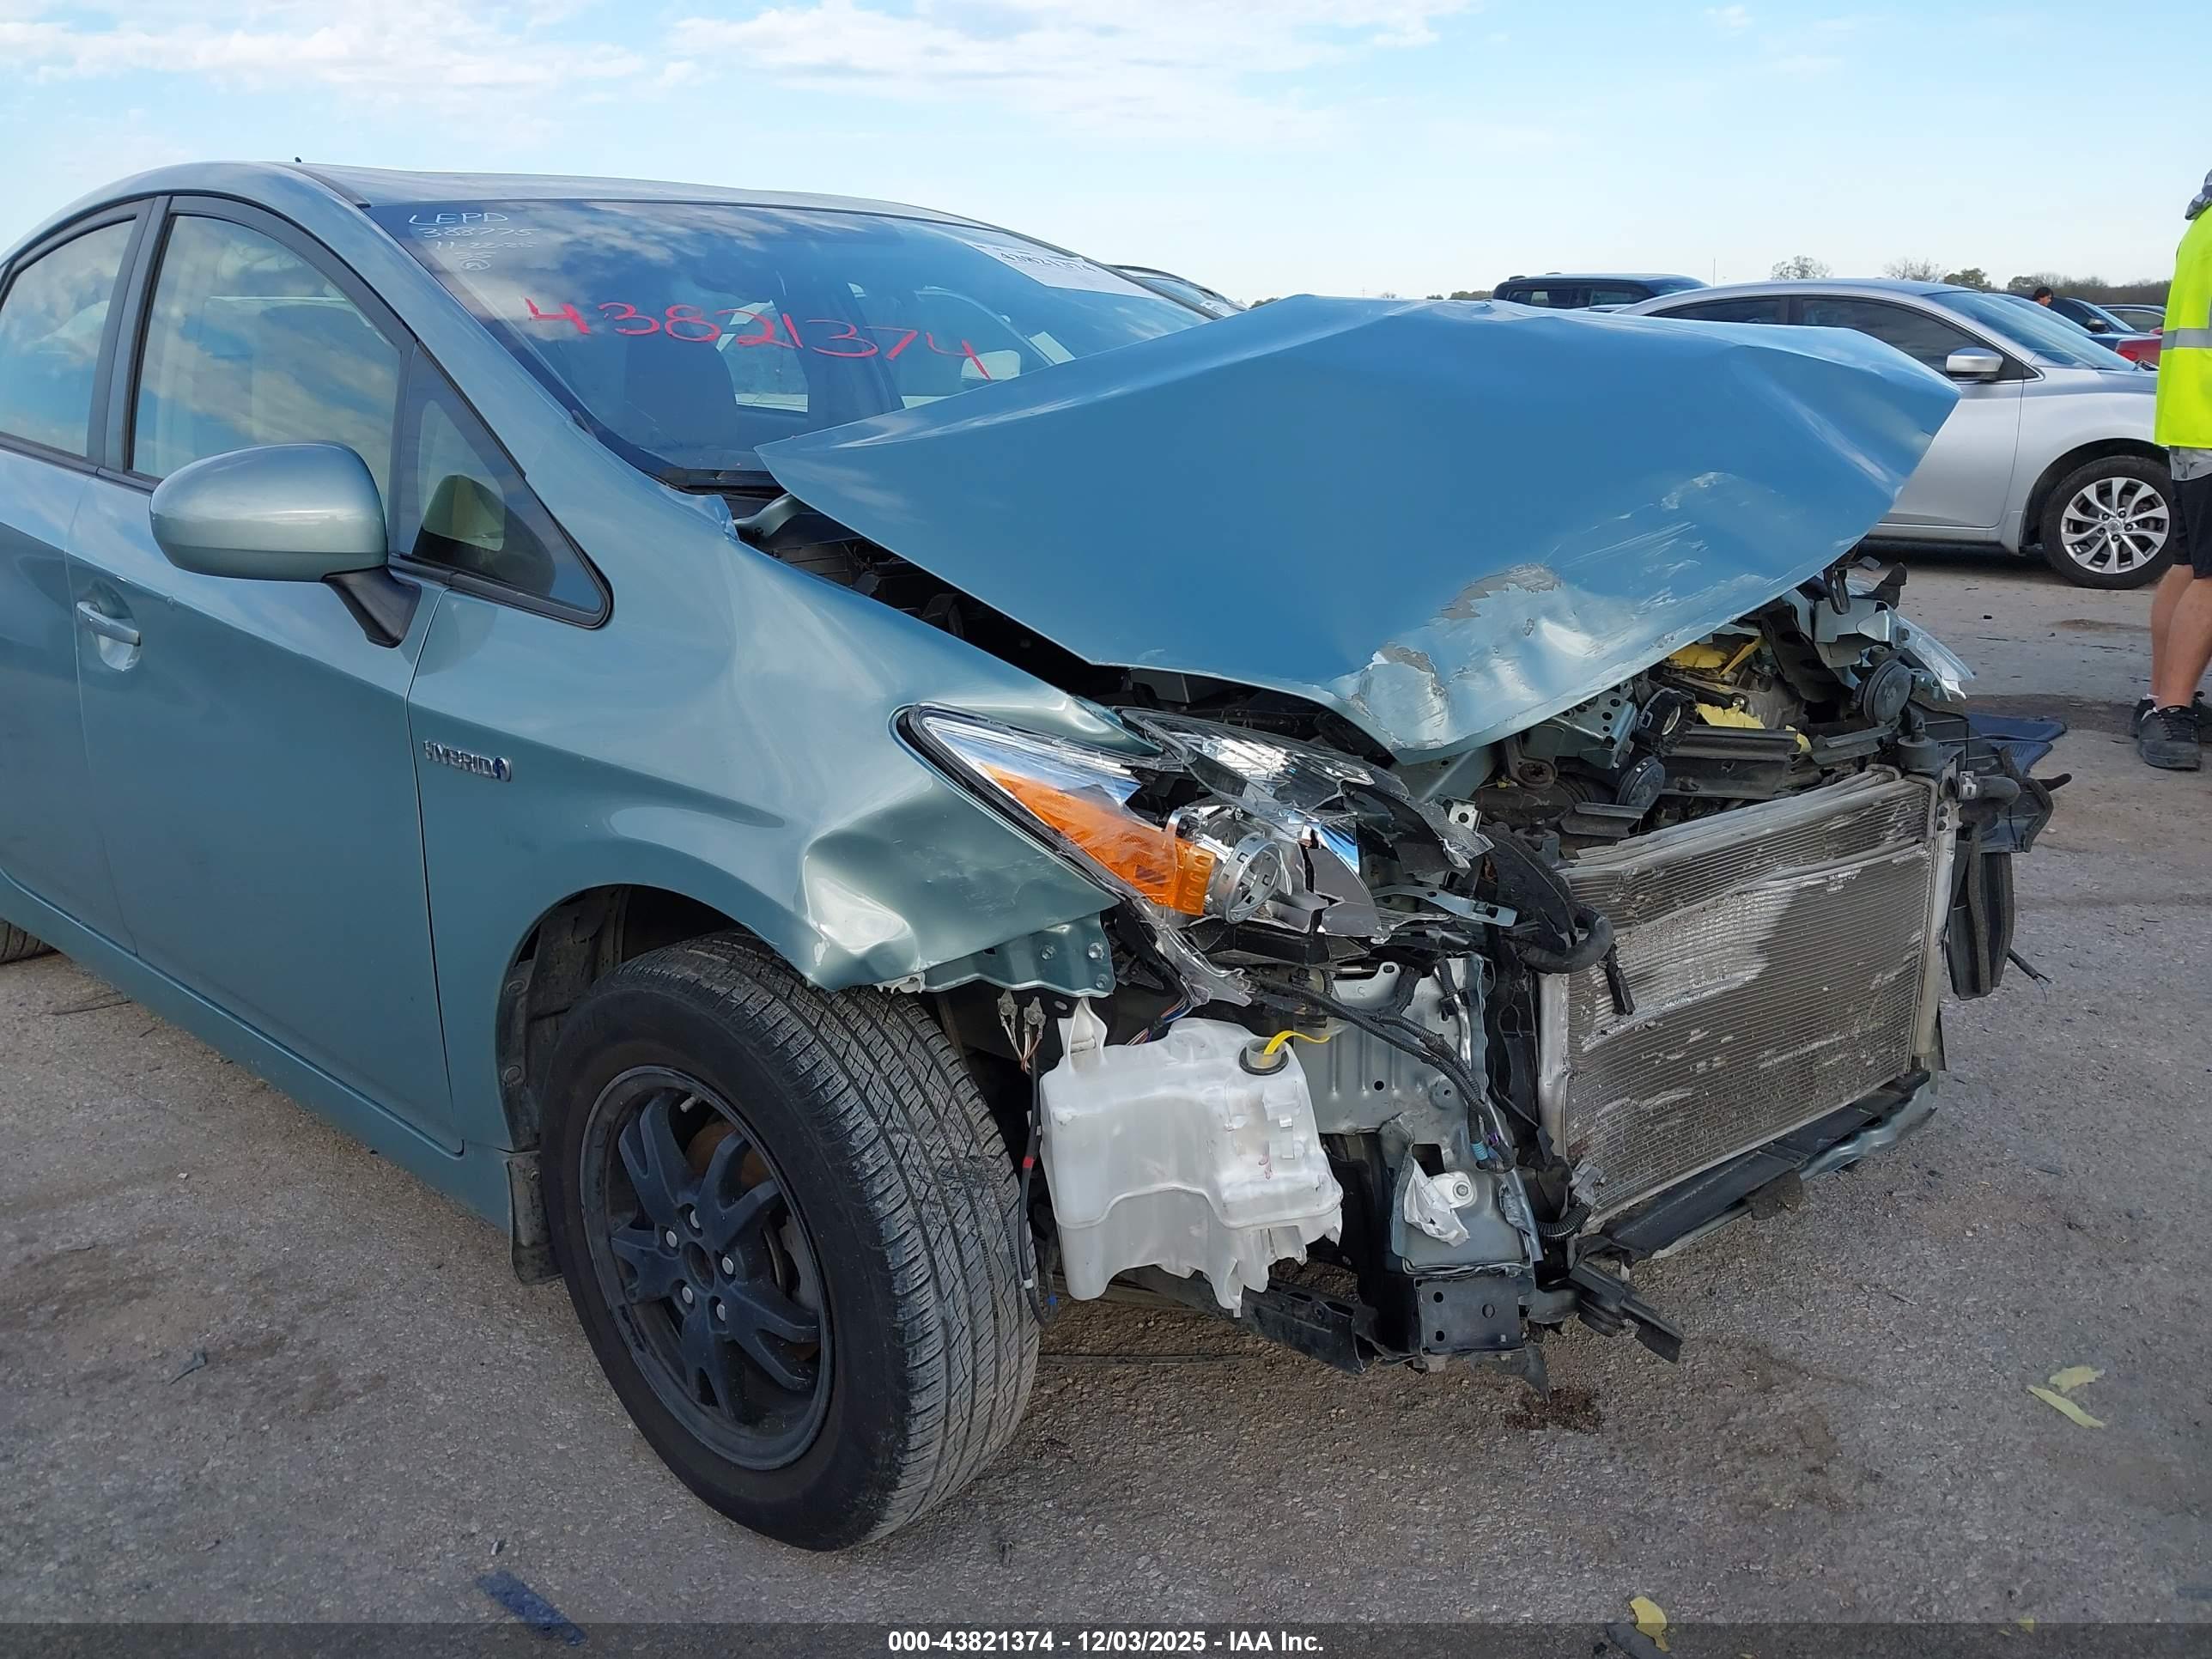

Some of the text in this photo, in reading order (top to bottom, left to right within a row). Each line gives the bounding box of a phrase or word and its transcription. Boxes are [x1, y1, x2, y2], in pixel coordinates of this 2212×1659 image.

[408, 212, 508, 226] LEPD
[418, 226, 541, 238] 388775
[525, 297, 990, 380] 43821374
[423, 739, 498, 780] HYBRID
